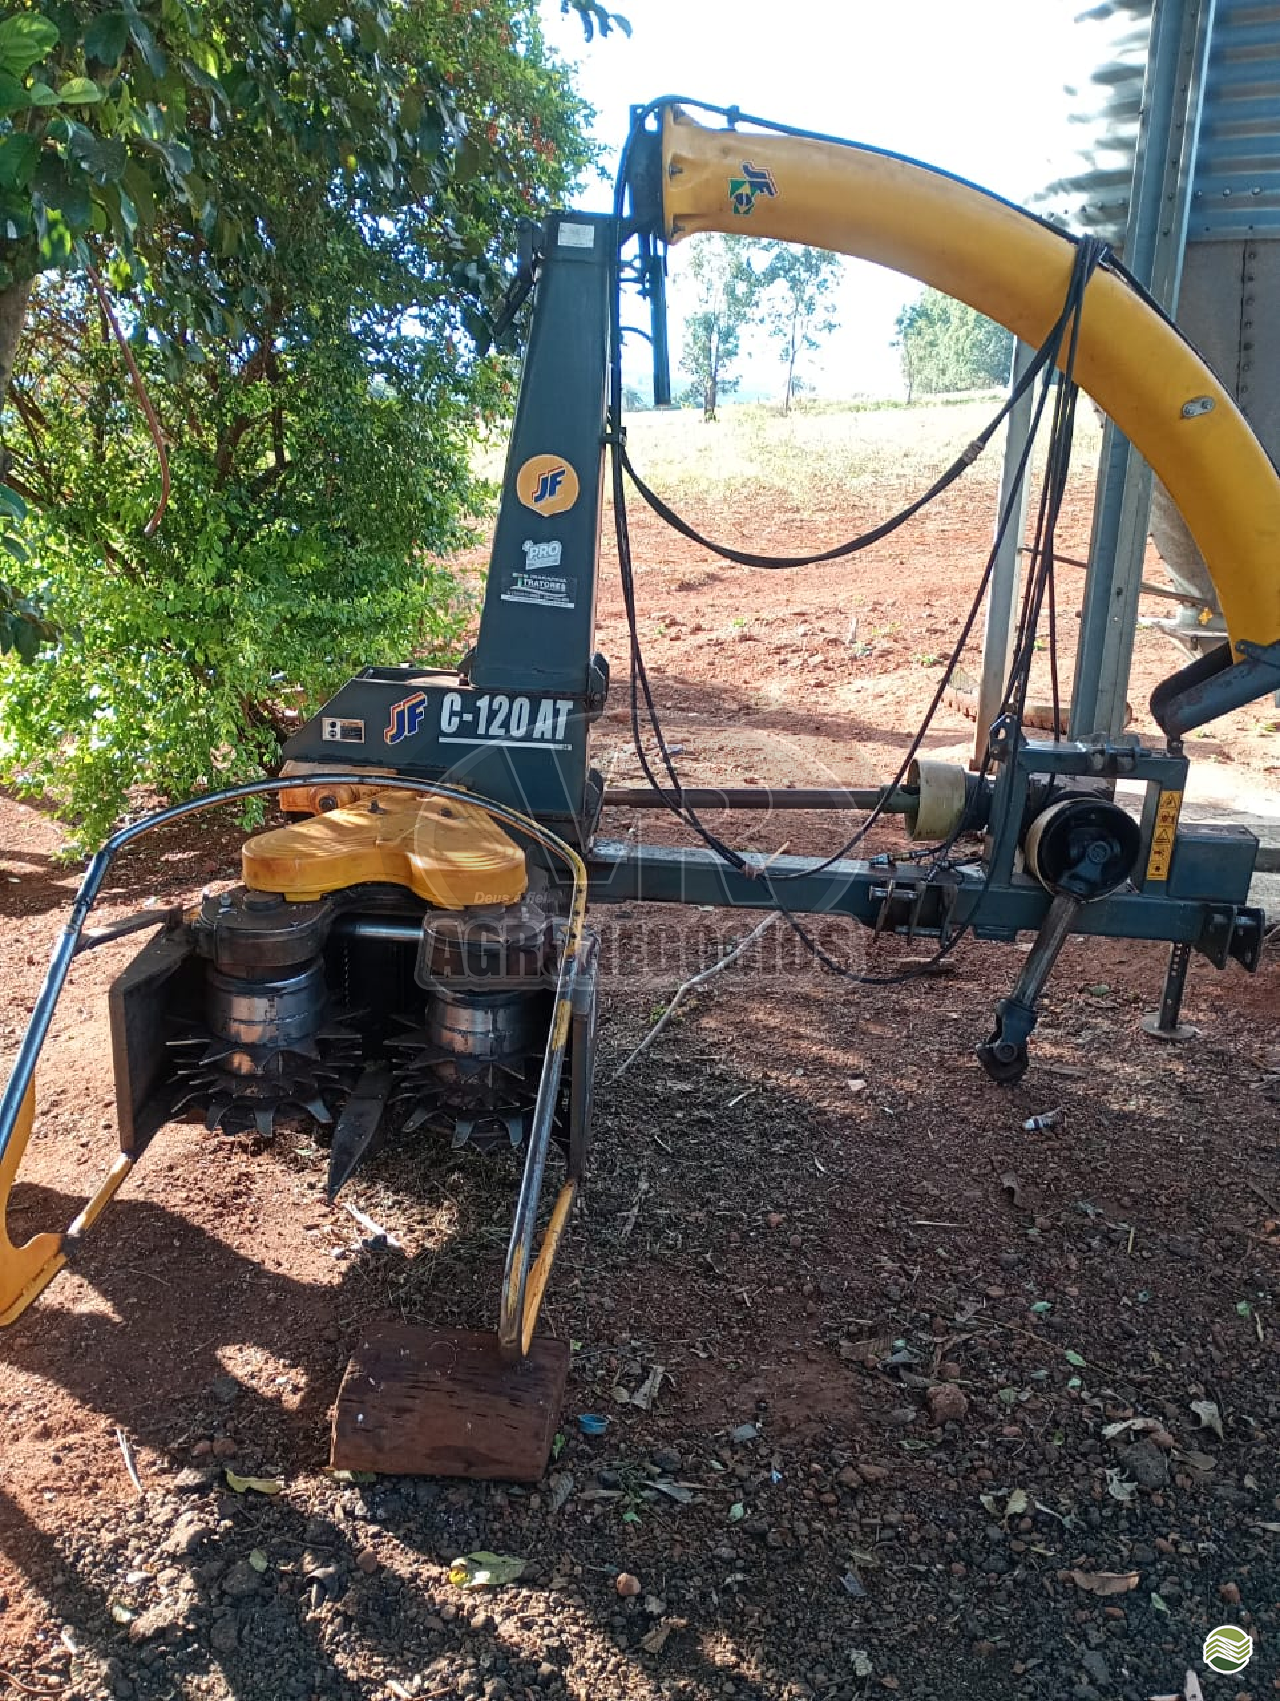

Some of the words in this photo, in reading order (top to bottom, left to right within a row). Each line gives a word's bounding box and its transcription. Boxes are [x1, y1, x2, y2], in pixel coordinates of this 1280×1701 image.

[532, 466, 566, 504] JF
[384, 691, 428, 745] JF
[440, 691, 531, 738] C-120
[532, 698, 574, 741] AT
